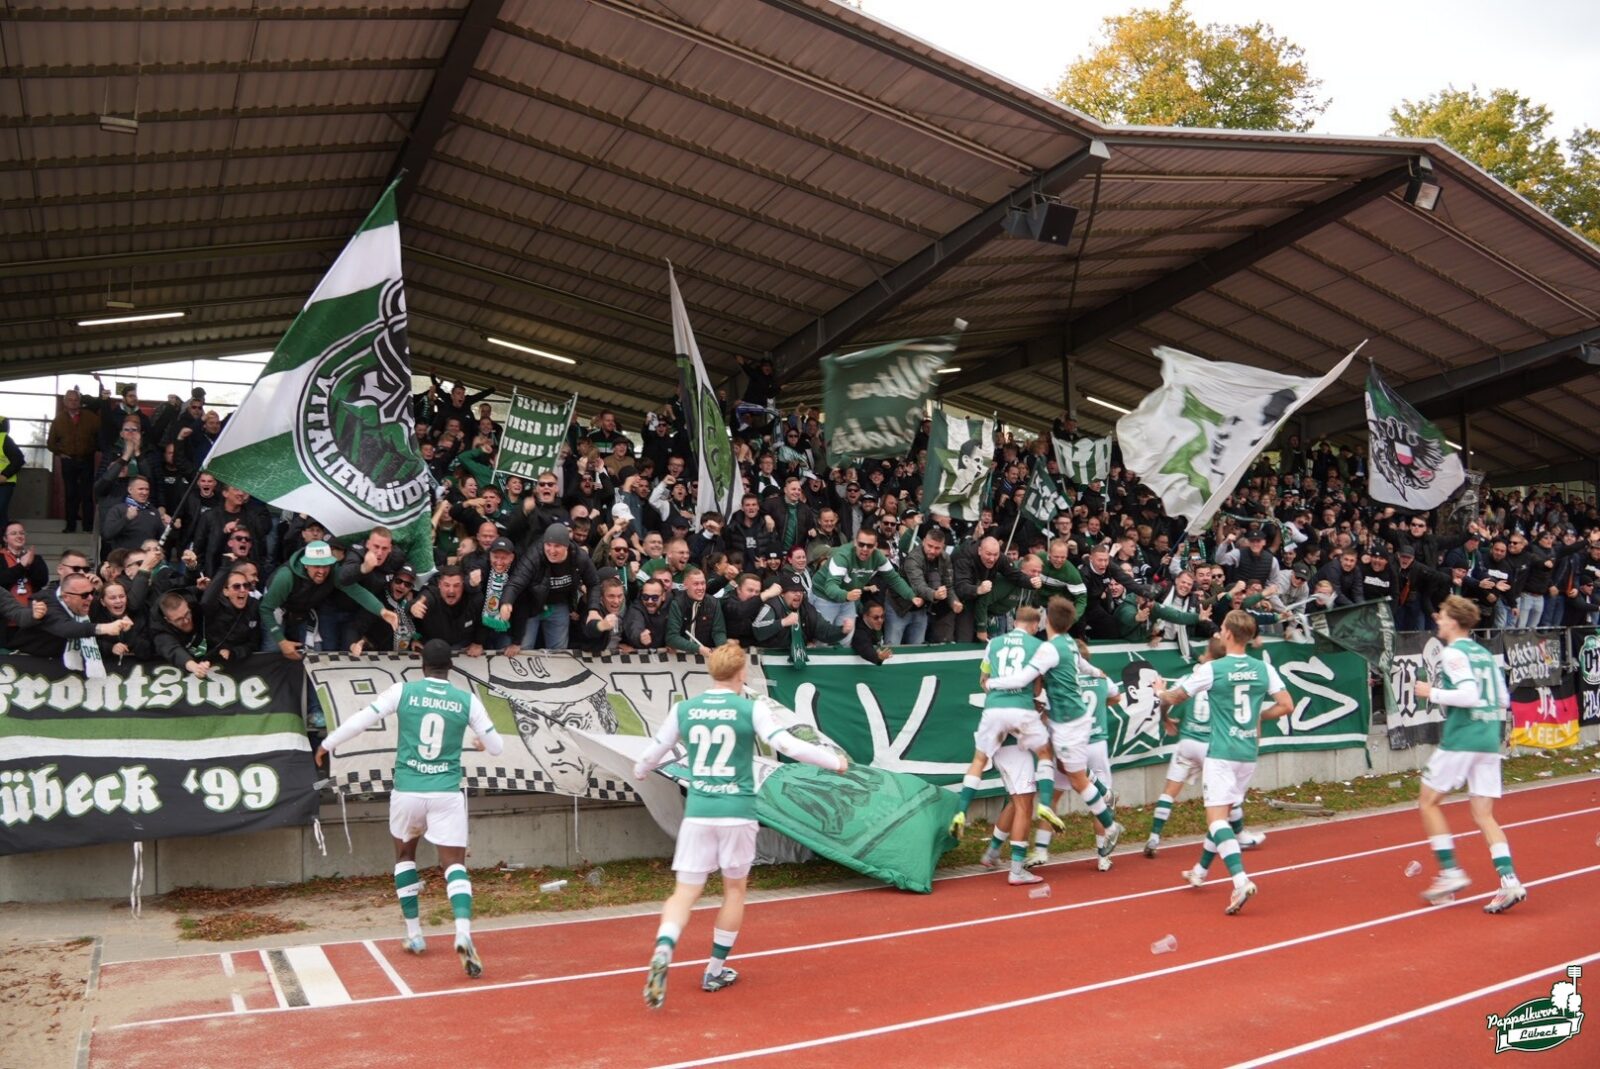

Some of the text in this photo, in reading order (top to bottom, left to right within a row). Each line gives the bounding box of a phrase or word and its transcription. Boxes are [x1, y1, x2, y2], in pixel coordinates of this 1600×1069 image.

[1004, 637, 1024, 646] THIEL
[996, 646, 1026, 678] 13
[1228, 671, 1258, 681] MENKE
[409, 696, 463, 713] H. BUKUSU
[688, 708, 738, 720] SOMMER
[1193, 690, 1211, 723] 6
[1234, 684, 1252, 724] 5
[417, 712, 446, 760] 9
[688, 724, 737, 777] 22
